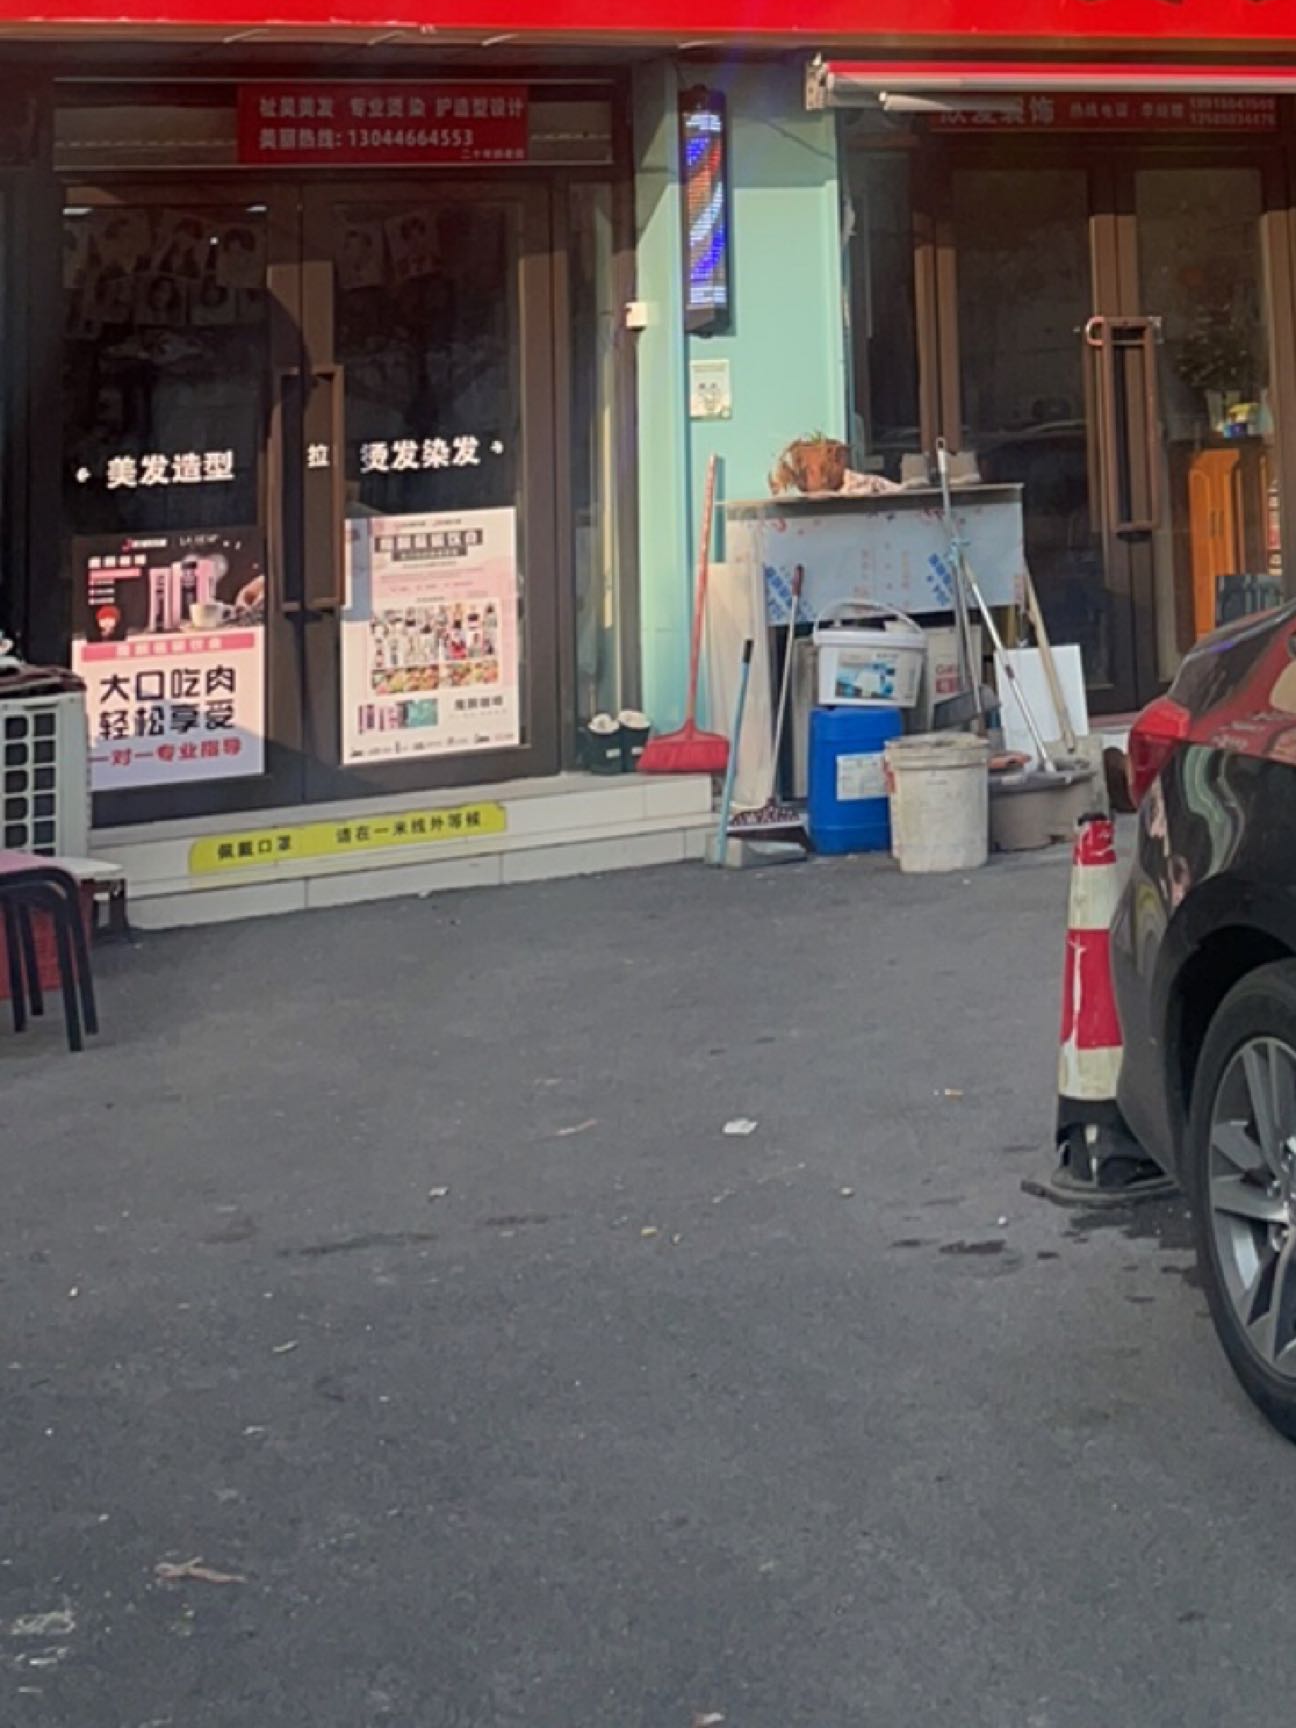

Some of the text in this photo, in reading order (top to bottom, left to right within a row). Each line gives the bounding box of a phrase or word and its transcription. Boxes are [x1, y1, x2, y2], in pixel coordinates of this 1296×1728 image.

[107, 450, 235, 489] 美发造型
[308, 444, 330, 468] 拉
[360, 435, 481, 474] 烫发染发
[100, 664, 237, 704] 大口吃肉
[100, 699, 235, 741] 轻松享受
[87, 736, 241, 766] 一对一专业指导
